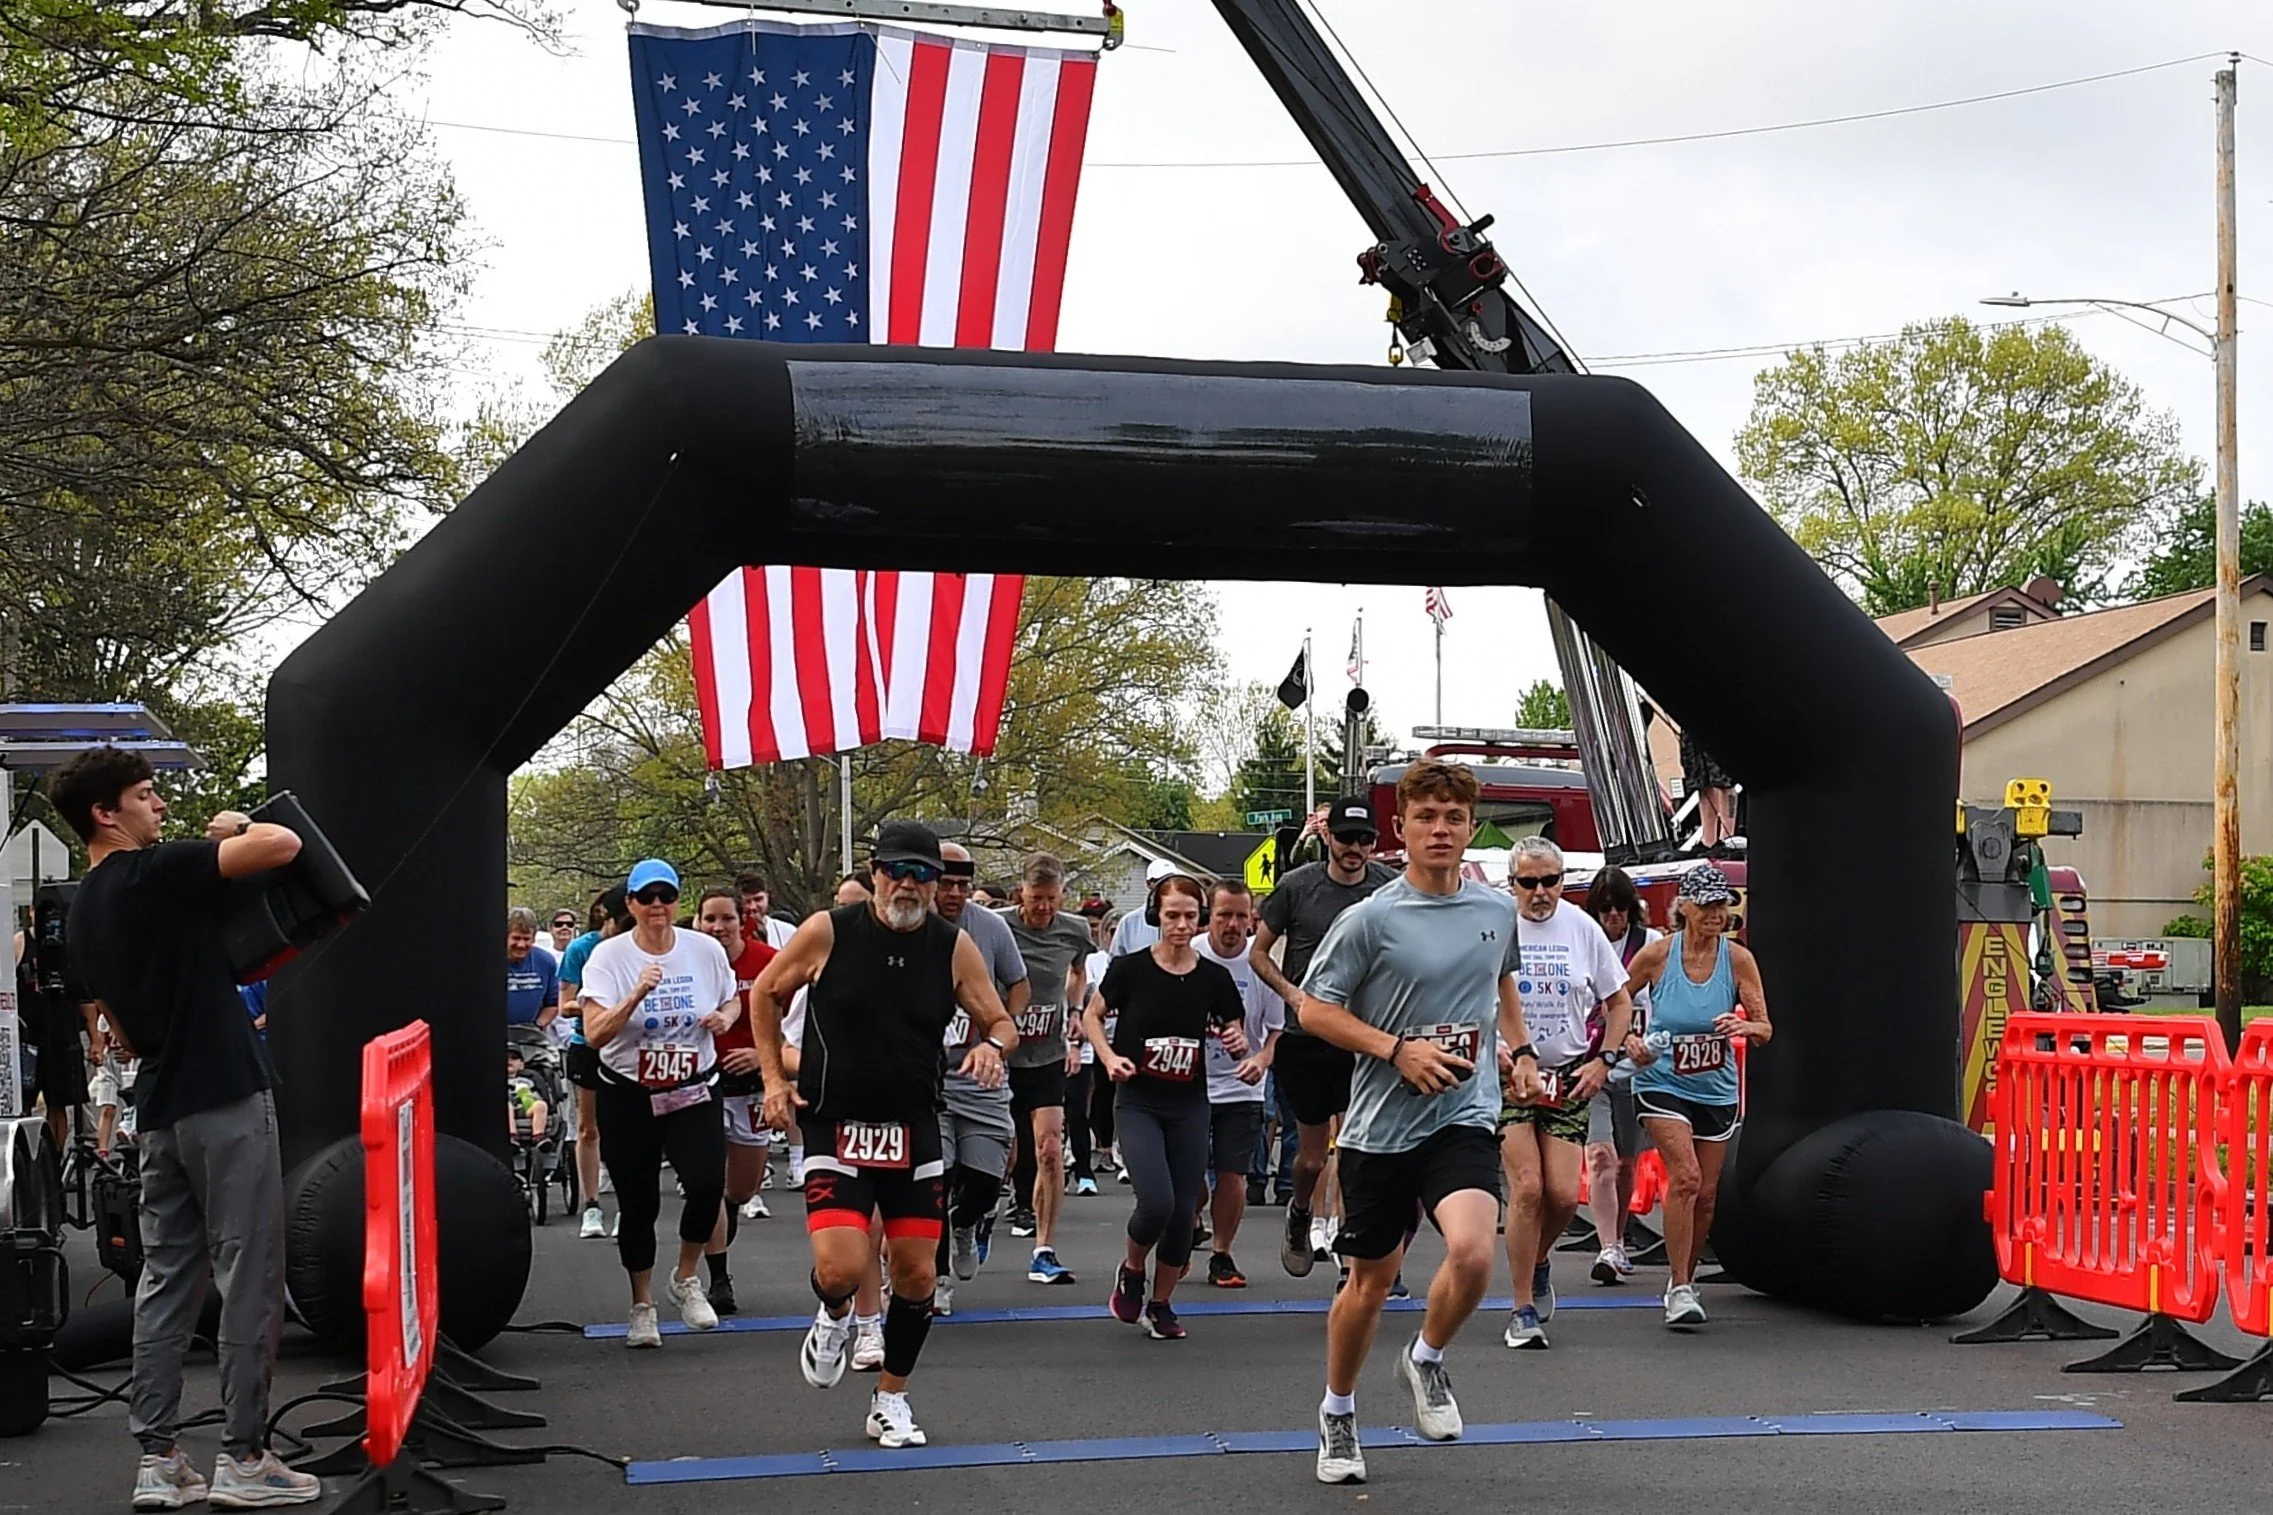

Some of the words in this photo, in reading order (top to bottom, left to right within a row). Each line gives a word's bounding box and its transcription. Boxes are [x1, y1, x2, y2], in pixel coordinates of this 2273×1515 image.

[1519, 963, 1532, 976] BE
[1548, 963, 1569, 976] ONE
[1538, 982, 1552, 994] 5K
[644, 997, 658, 1012] BE
[674, 995, 695, 1009] ONE
[663, 1015, 679, 1028] 5K
[1016, 1013, 1050, 1036] 2941
[644, 1051, 693, 1081] 2945
[1148, 1045, 1193, 1075] 2944
[1678, 1040, 1721, 1070] 2928
[1538, 1071, 1557, 1102] 54
[843, 1124, 904, 1162] 2929
